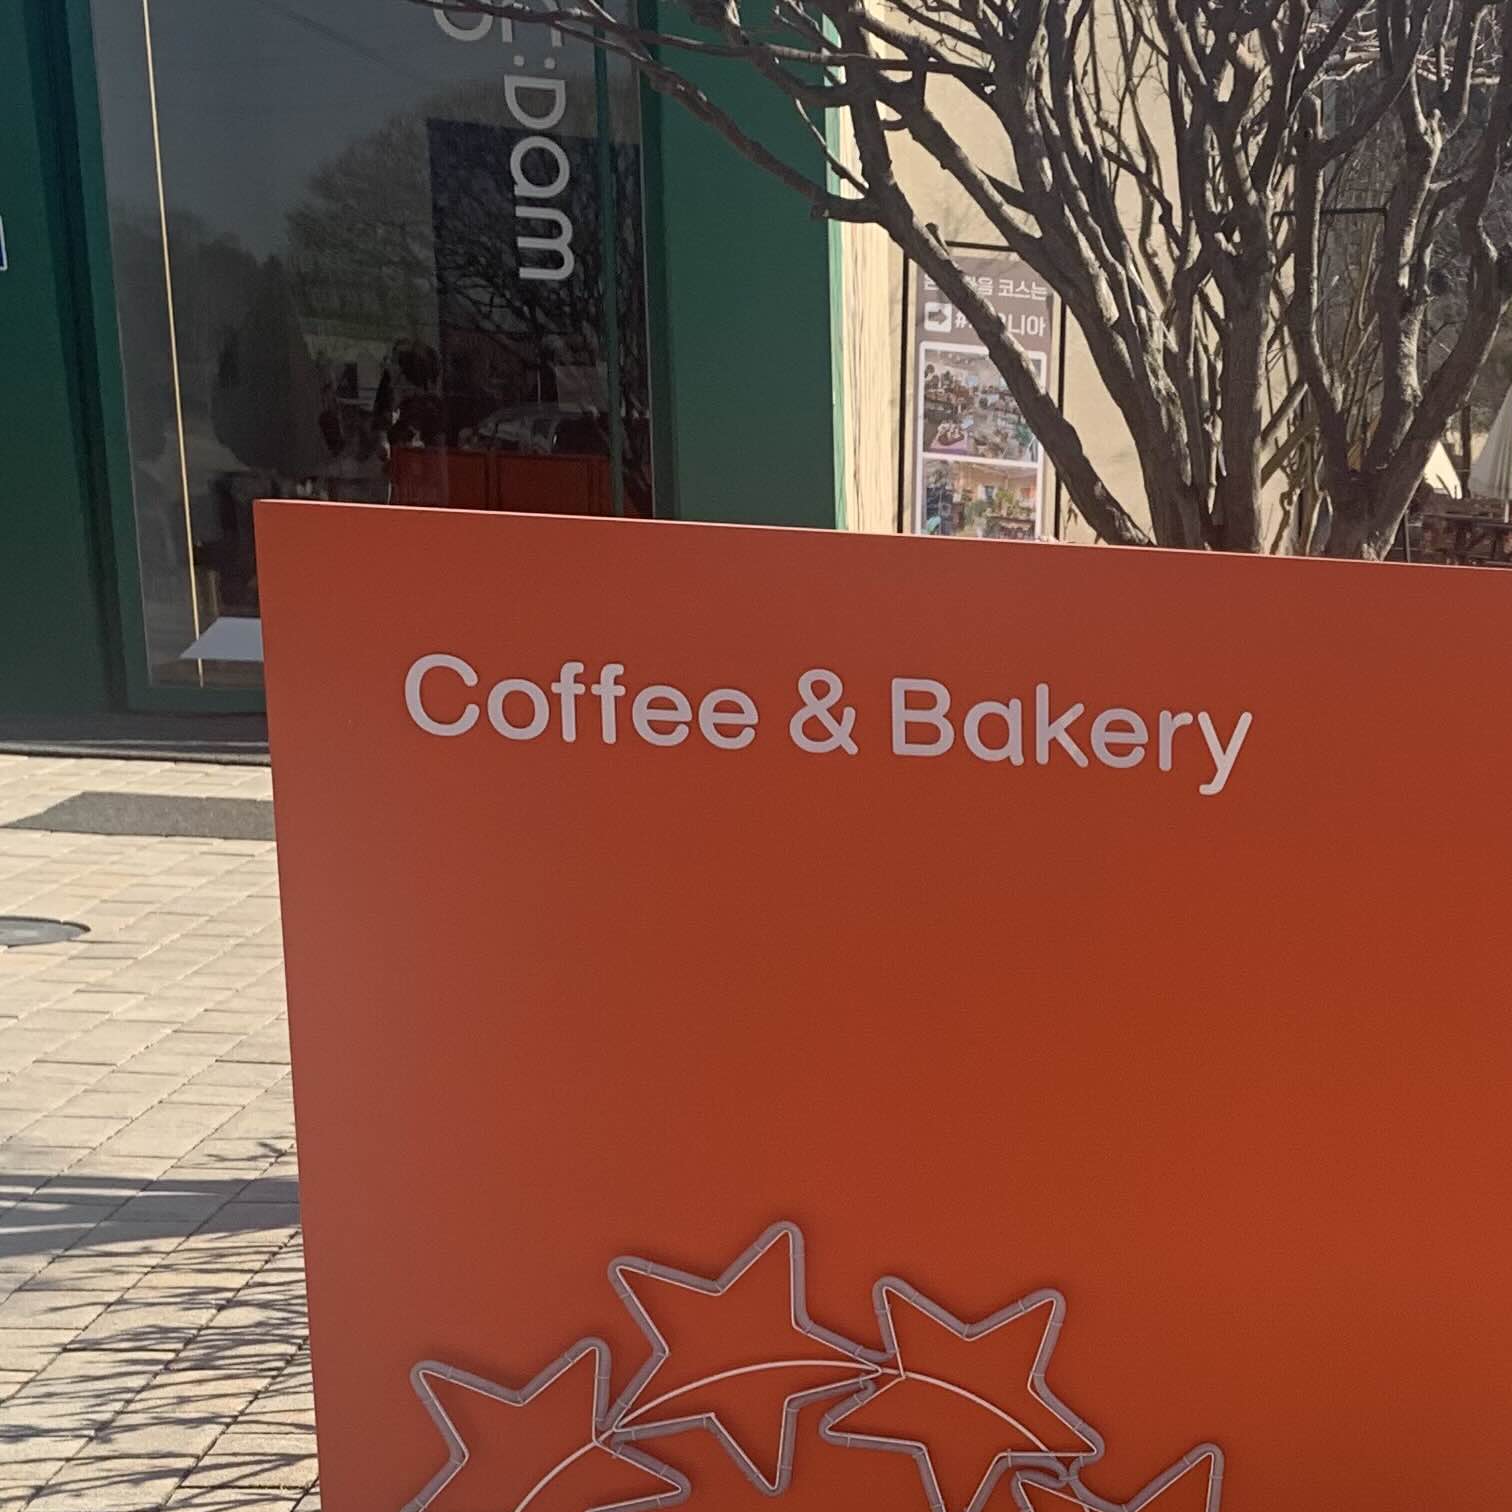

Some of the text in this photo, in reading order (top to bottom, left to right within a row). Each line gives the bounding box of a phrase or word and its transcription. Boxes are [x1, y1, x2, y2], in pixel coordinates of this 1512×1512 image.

[997, 278, 1048, 301] 코스는
[405, 654, 1253, 795] Coffee & Bakery
